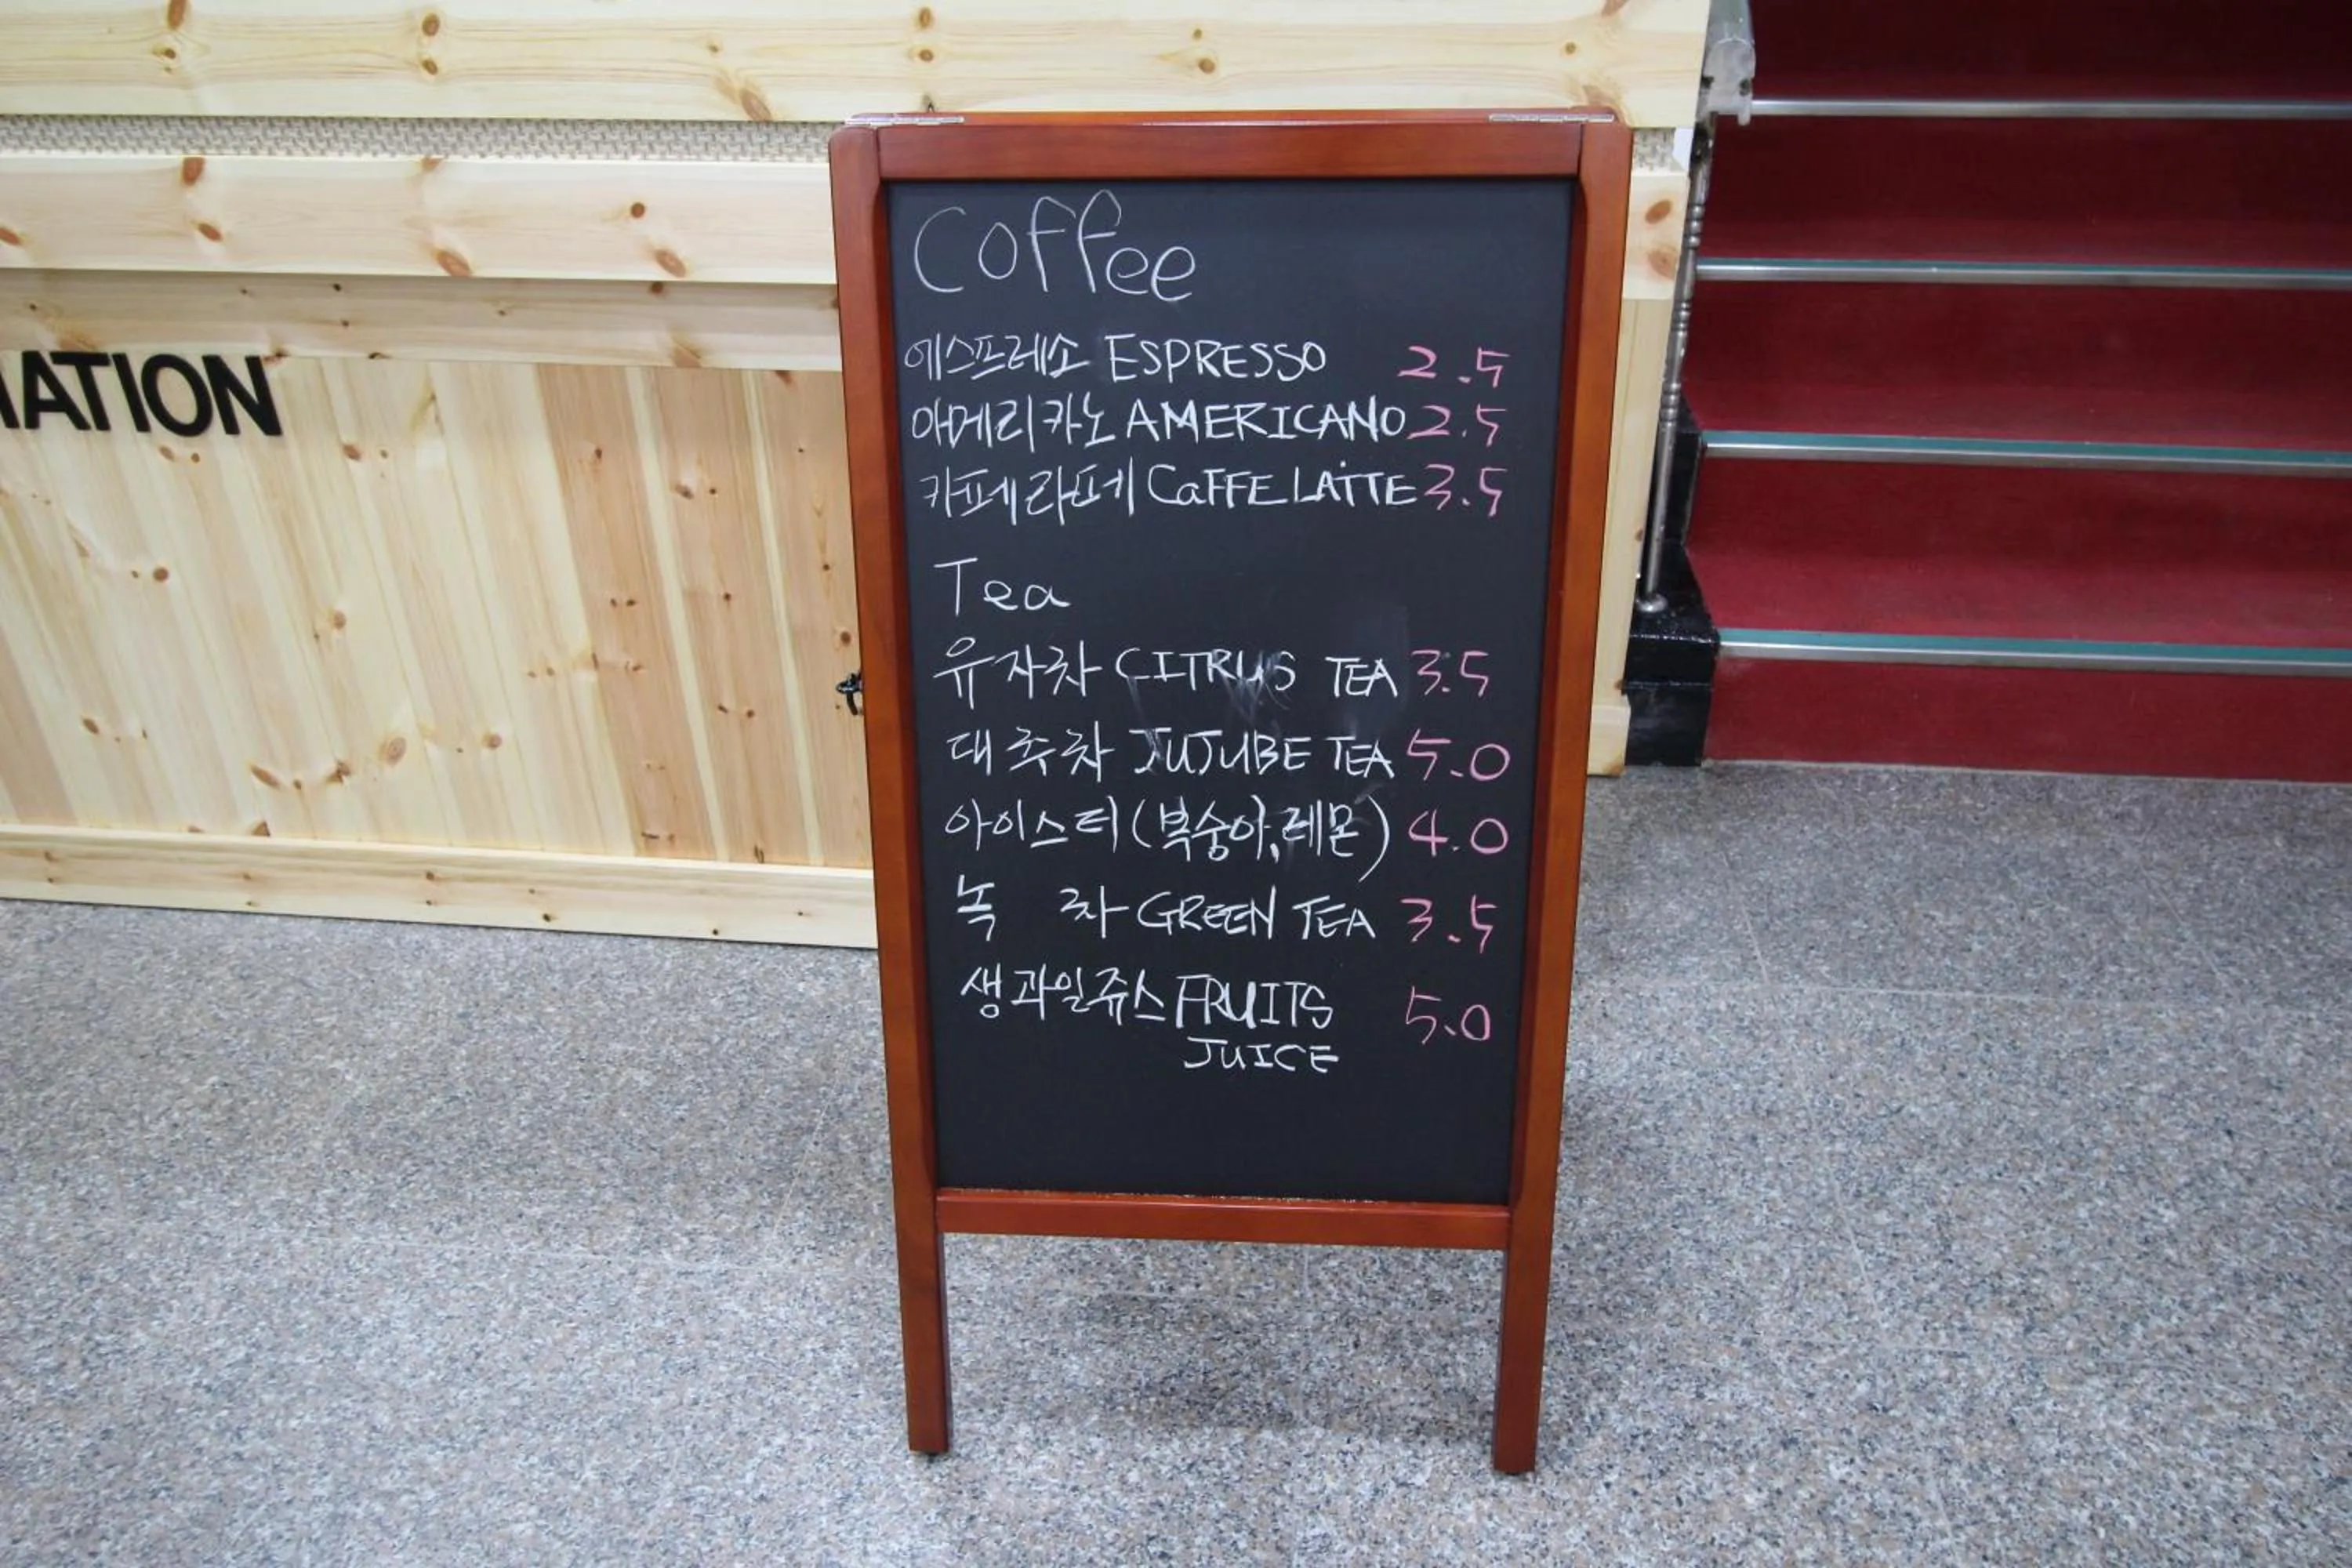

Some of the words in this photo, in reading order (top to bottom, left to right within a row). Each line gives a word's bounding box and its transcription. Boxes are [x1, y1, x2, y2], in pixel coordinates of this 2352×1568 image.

[913, 188, 1196, 301] Coffee
[904, 332, 1090, 381] 에스프레소
[1105, 332, 1327, 383] ESPRESSO
[1398, 346, 1509, 387] 2.5
[0, 350, 283, 437] ATION
[911, 393, 1116, 452] 아메리카노
[1126, 397, 1406, 441] AMERICANO
[1406, 405, 1507, 447] 2.5
[1422, 464, 1508, 516] 3.5
[934, 557, 1071, 617] Tea
[934, 637, 1102, 710] 유자차
[1115, 648, 1297, 693] CITRUS
[1325, 656, 1399, 699] TEA
[1411, 649, 1490, 696] 3.5
[1129, 728, 1312, 776] JUJUBE
[1326, 735, 1394, 778] TEA
[1406, 730, 1512, 780] 5.0
[1408, 808, 1510, 857] 4.0
[1136, 886, 1276, 940] GREEN
[1293, 895, 1377, 939] TEA
[1401, 895, 1497, 953] 3.5
[1174, 975, 1334, 1030] FRUITS
[1405, 985, 1492, 1045] 5.0
[1183, 1036, 1340, 1073] JUICE
